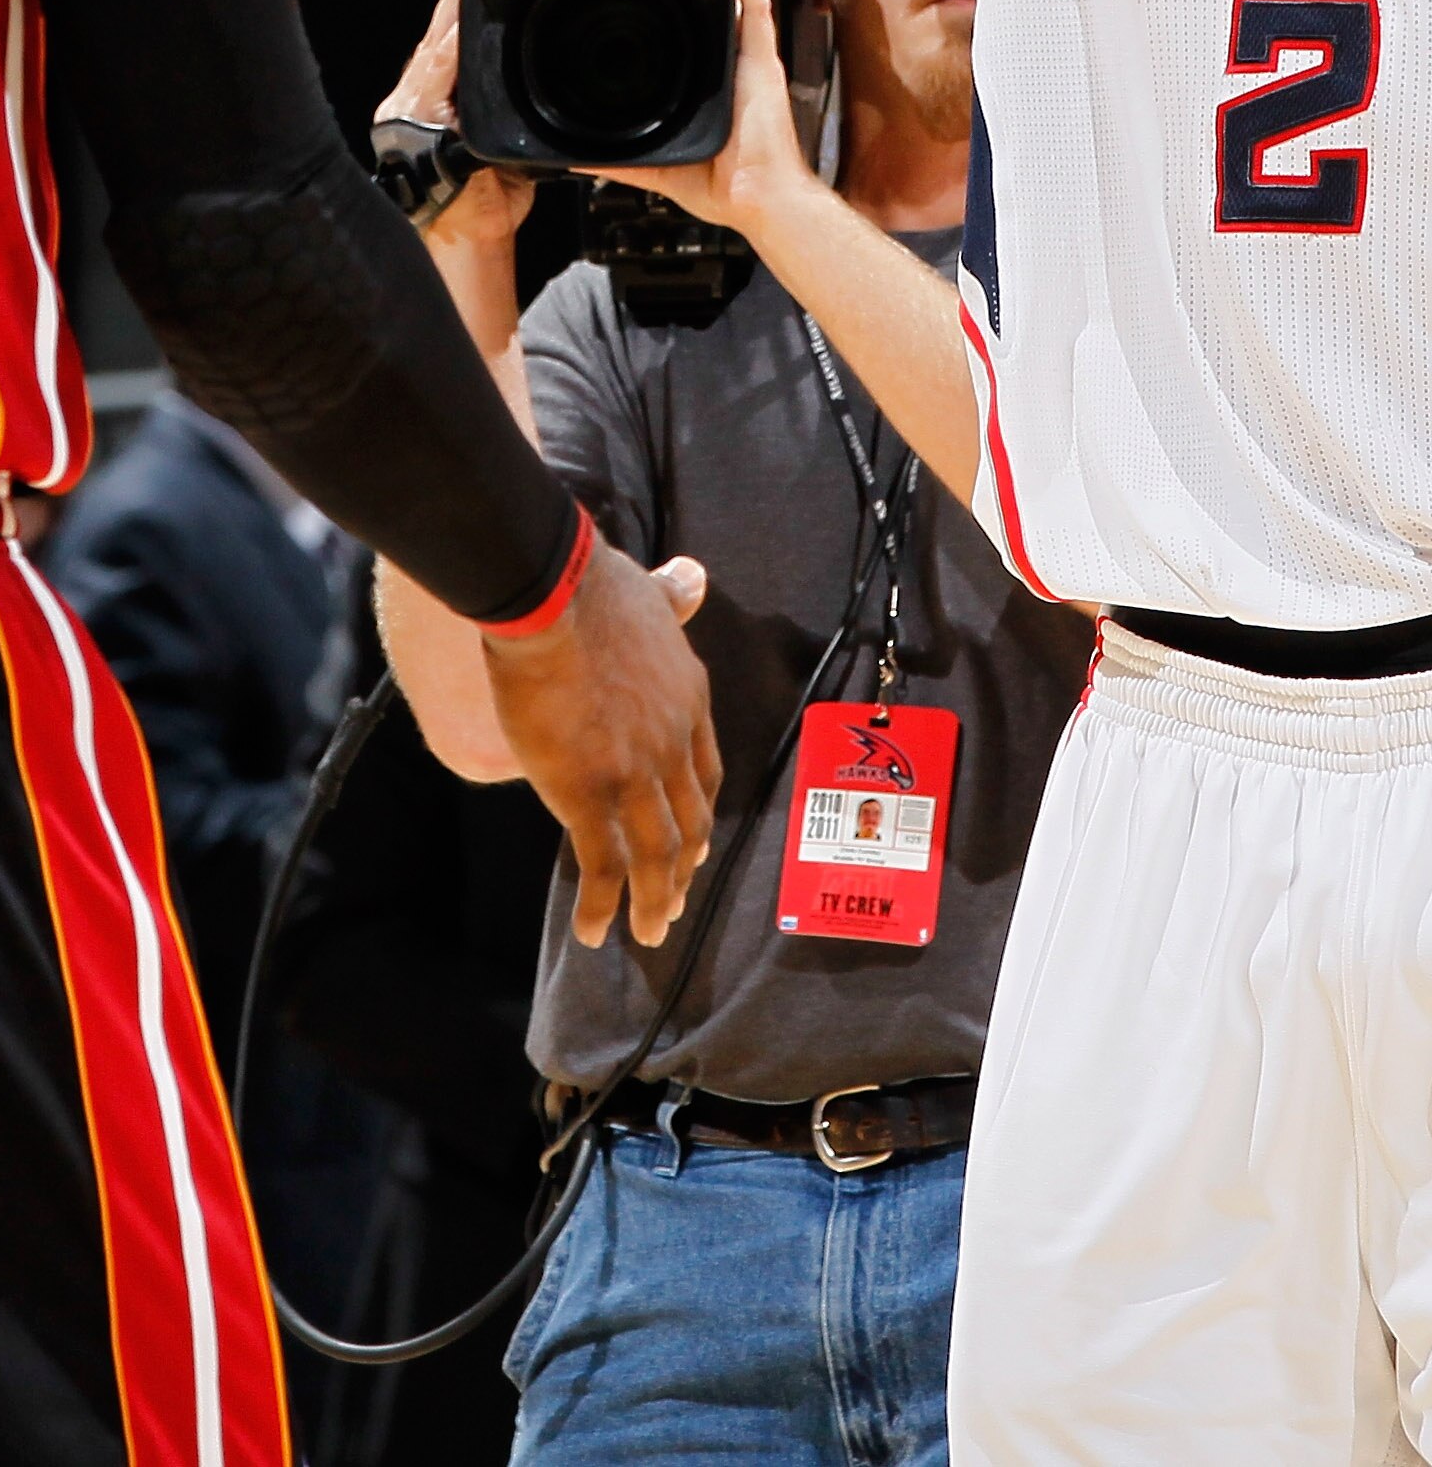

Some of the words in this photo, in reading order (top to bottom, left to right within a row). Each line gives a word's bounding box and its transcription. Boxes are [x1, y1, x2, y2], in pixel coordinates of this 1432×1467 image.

[810, 792, 843, 814] 2010
[806, 816, 839, 840] 2011
[821, 892, 841, 913] TV
[845, 895, 894, 918] CREW
